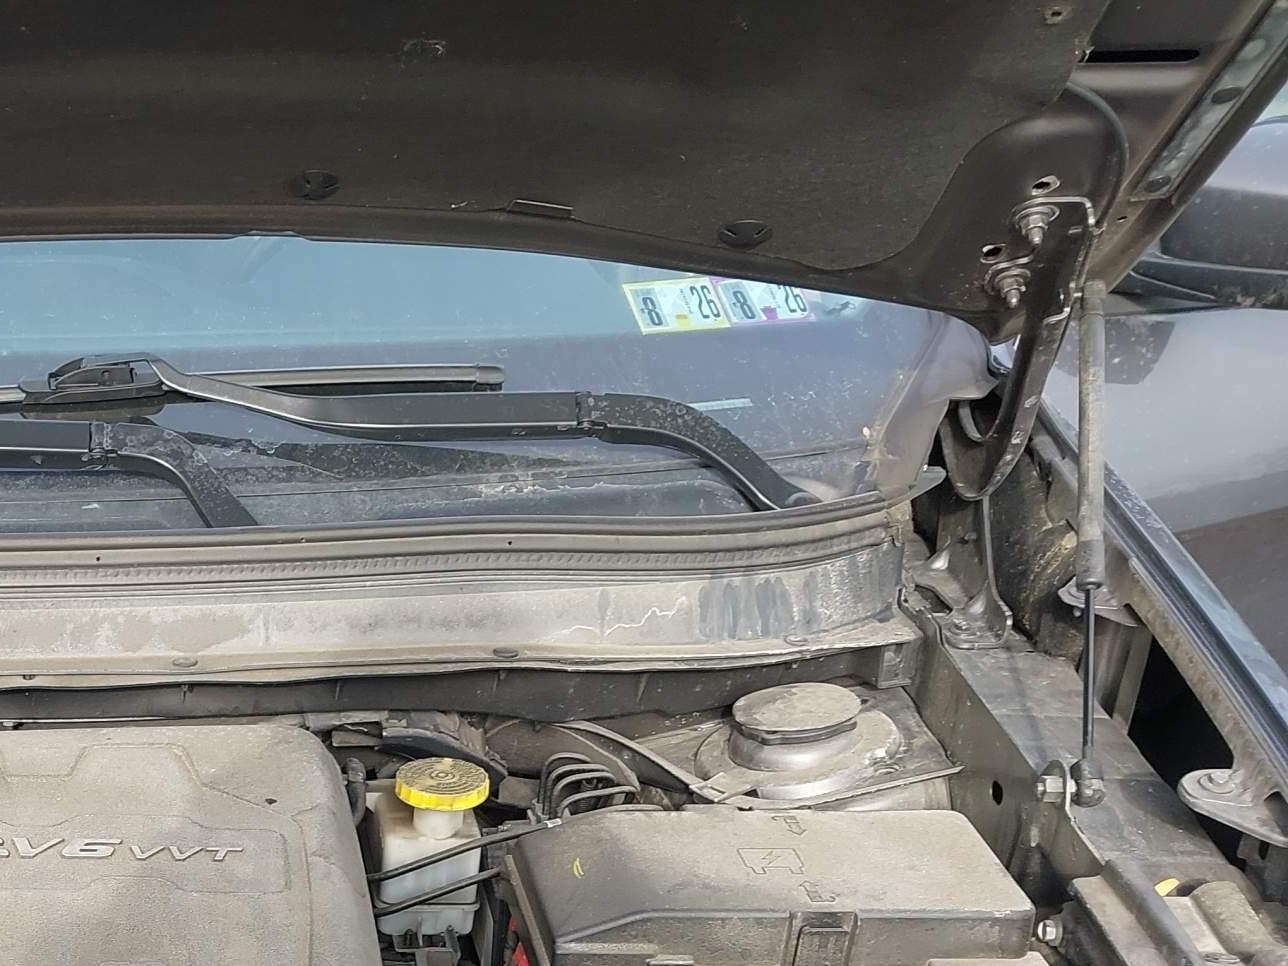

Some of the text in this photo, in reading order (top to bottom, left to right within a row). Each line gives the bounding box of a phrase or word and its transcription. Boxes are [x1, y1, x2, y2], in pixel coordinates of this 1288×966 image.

[641, 296, 663, 326] 8
[689, 284, 721, 320] 26
[732, 290, 756, 320] 8
[777, 284, 808, 314] 26
[13, 836, 244, 861] V6 VVT
